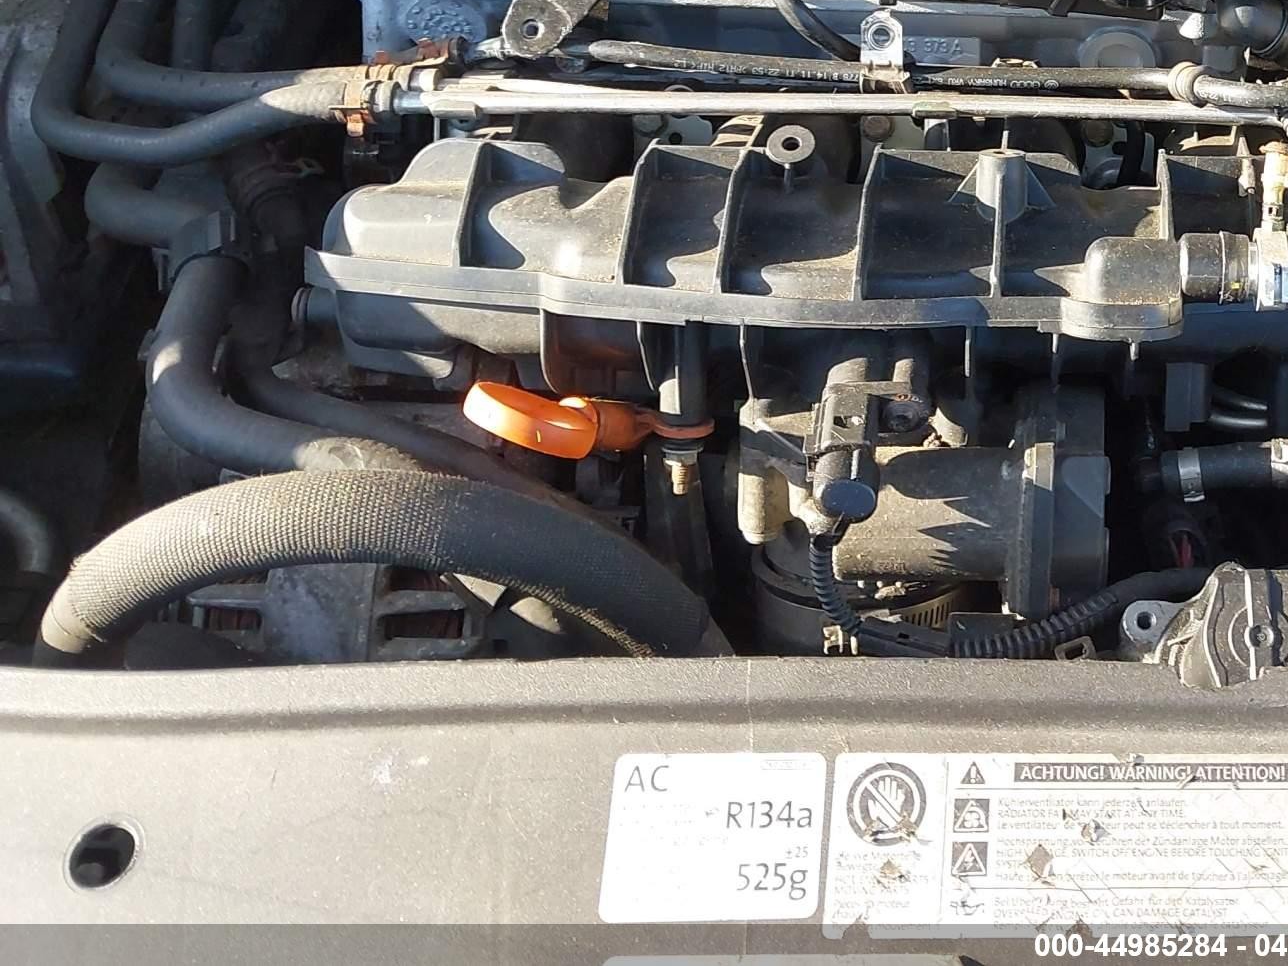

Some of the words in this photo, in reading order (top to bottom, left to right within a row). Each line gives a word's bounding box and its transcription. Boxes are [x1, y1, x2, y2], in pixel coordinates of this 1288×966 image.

[624, 765, 671, 793] AC
[1020, 765, 1105, 781] ACHTUNG!
[1109, 765, 1191, 781] WARNING!
[1194, 765, 1287, 781] ATTENTION!
[726, 800, 813, 829] R134a
[998, 809, 1048, 819] RADIATOR
[1071, 848, 1110, 858] SWITCH
[736, 862, 809, 901] 525g
[1112, 872, 1147, 881] moteur
